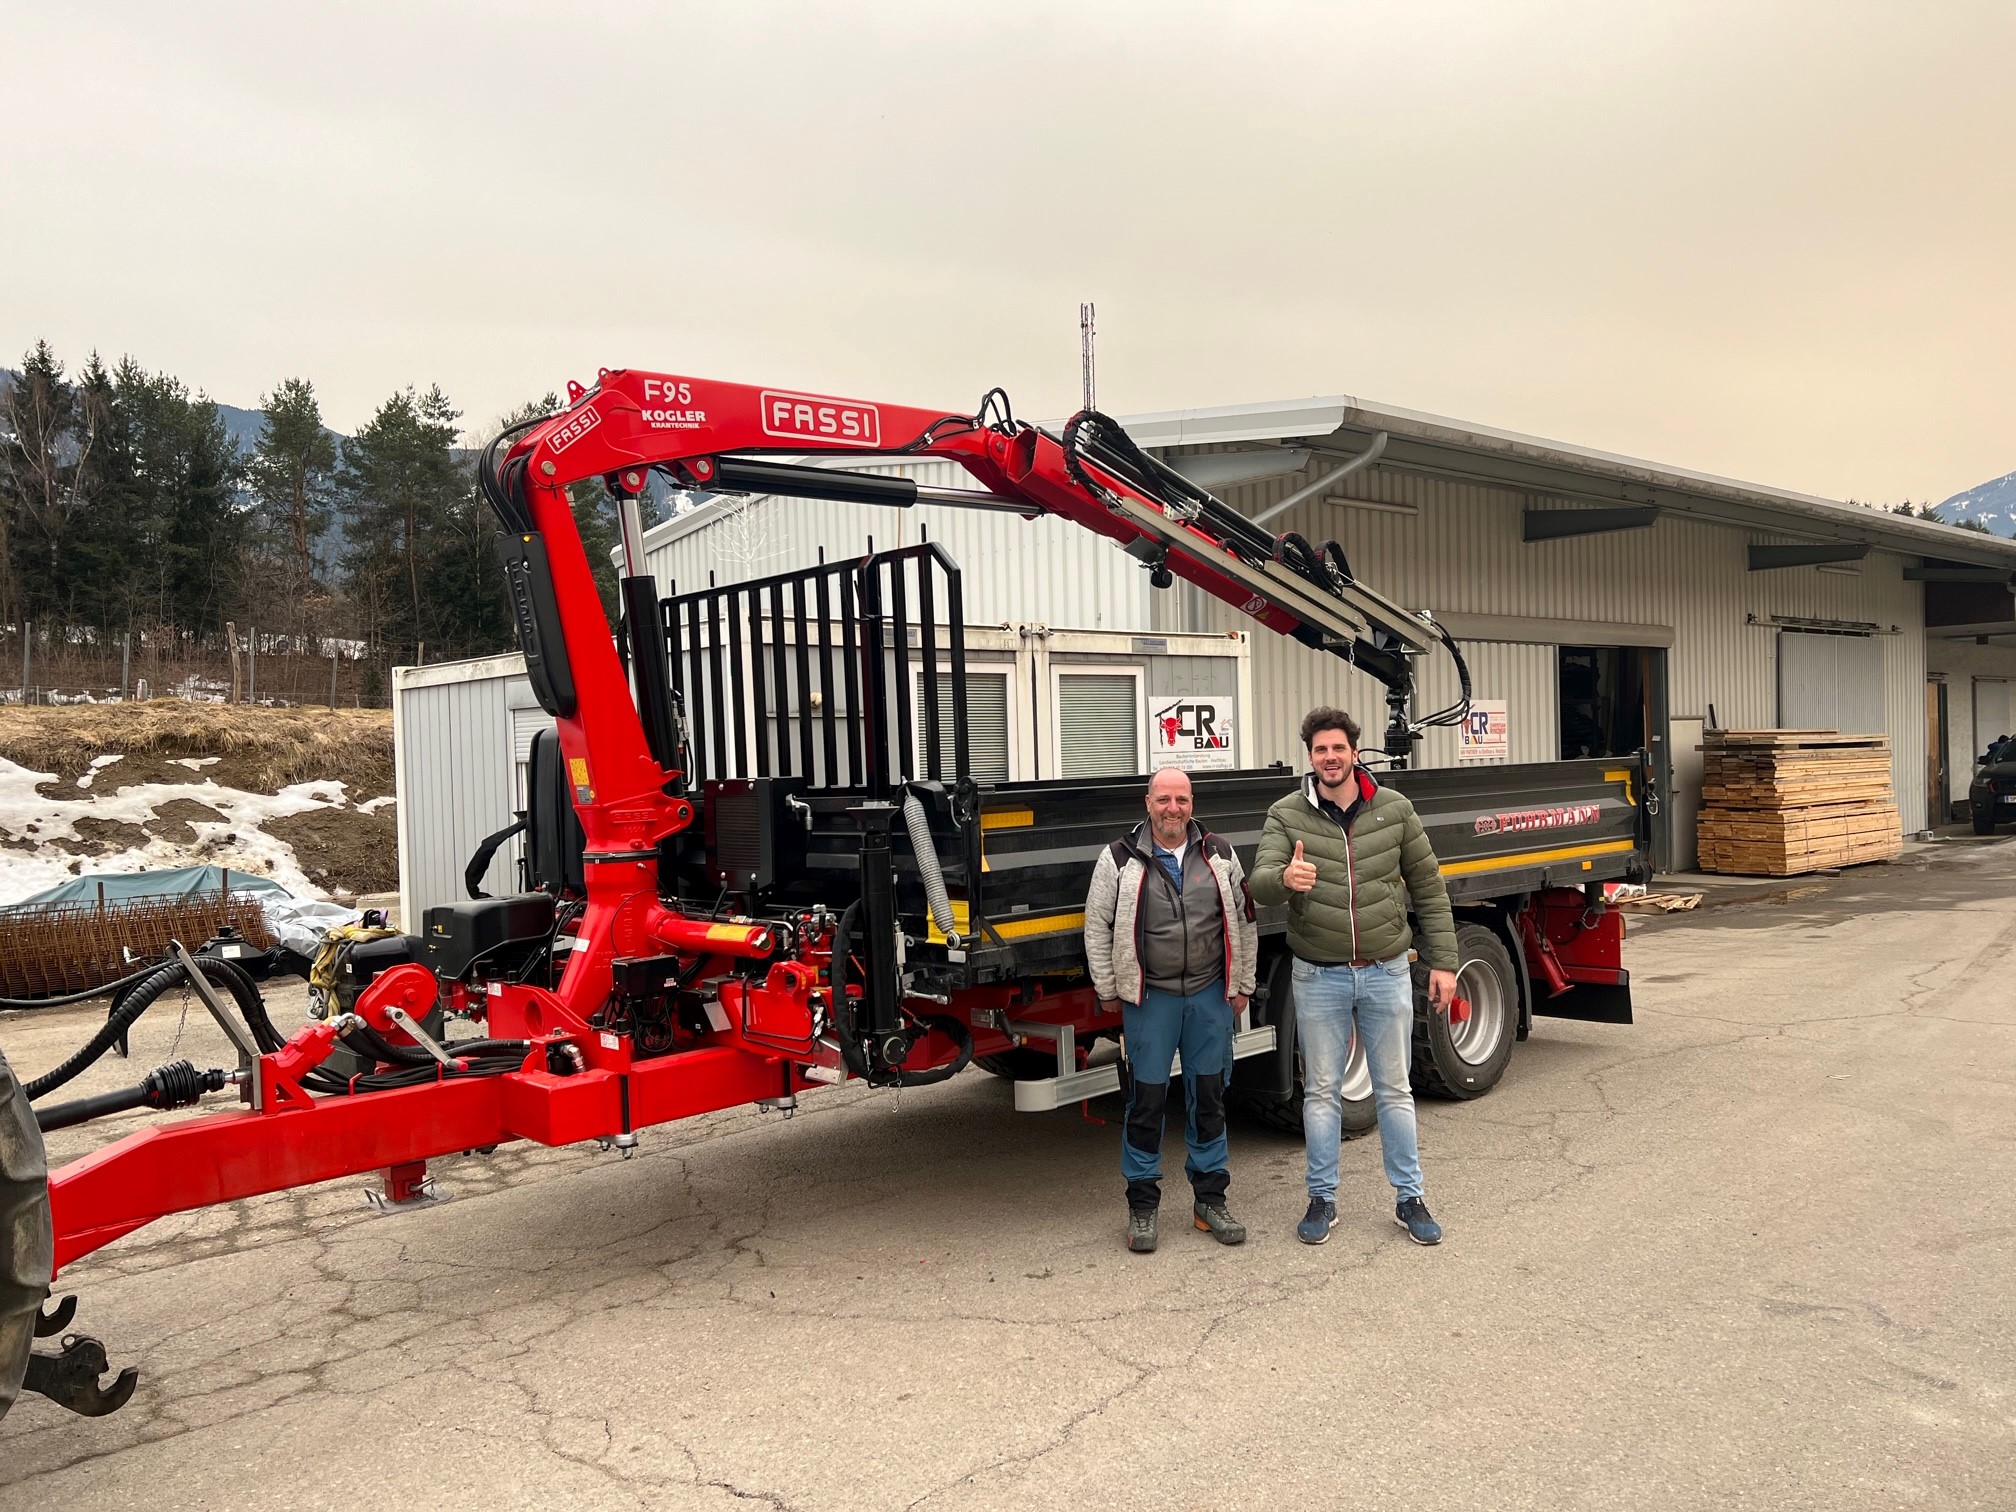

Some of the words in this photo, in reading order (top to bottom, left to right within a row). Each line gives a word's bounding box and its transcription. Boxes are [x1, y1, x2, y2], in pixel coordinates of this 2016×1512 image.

[643, 379, 692, 405] F95
[641, 409, 706, 422] KOGLER
[772, 401, 870, 438] FASSI
[552, 410, 596, 449] FASSI
[1176, 704, 1216, 737] CR
[1470, 711, 1488, 735] CR
[1193, 735, 1229, 749] BAU
[1464, 735, 1483, 745] BAU
[1495, 804, 1600, 834] FUHRMANN
